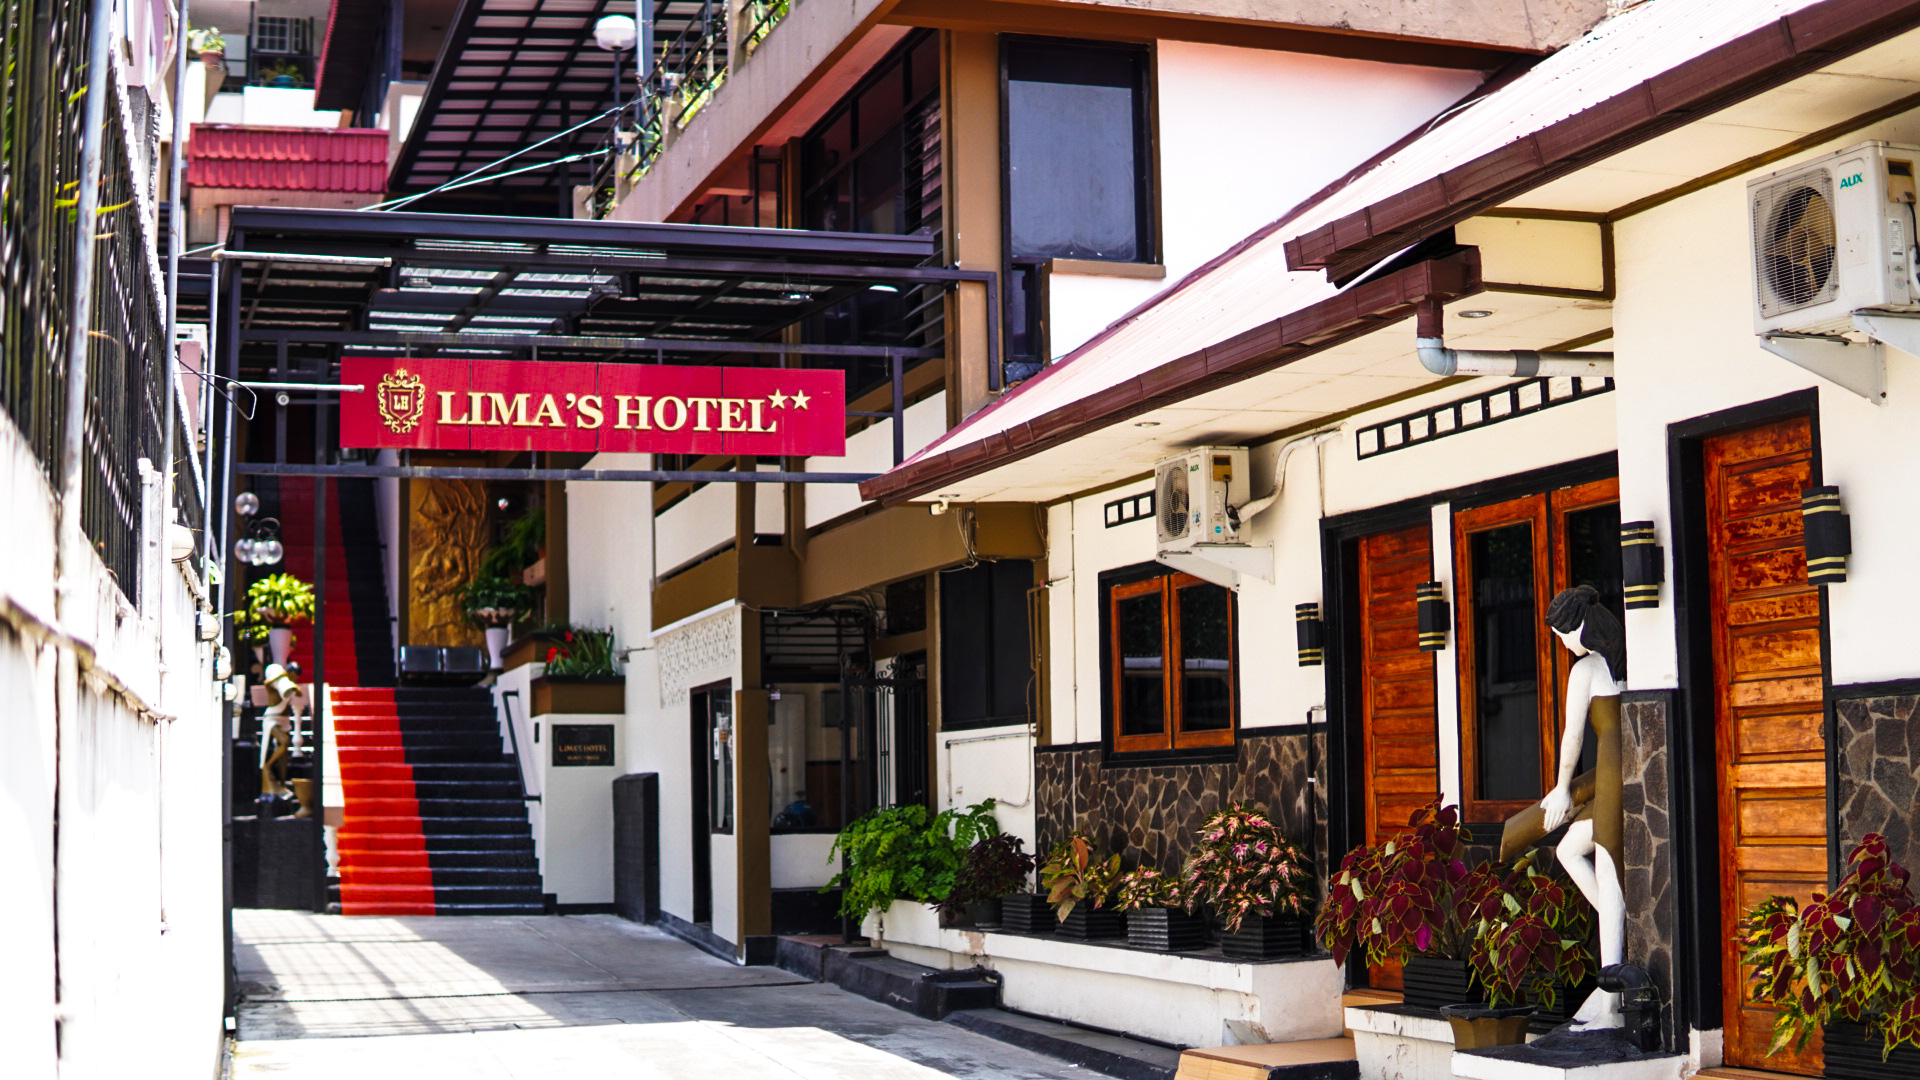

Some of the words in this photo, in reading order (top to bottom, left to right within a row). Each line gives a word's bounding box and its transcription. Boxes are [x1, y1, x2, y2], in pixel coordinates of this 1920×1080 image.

[1839, 172, 1863, 189] AUX
[393, 395, 409, 410] LH
[437, 391, 605, 429] LIMA'S
[613, 394, 777, 432] HOTEL
[1189, 464, 1199, 472] AUX
[584, 744, 607, 752] HOTEL
